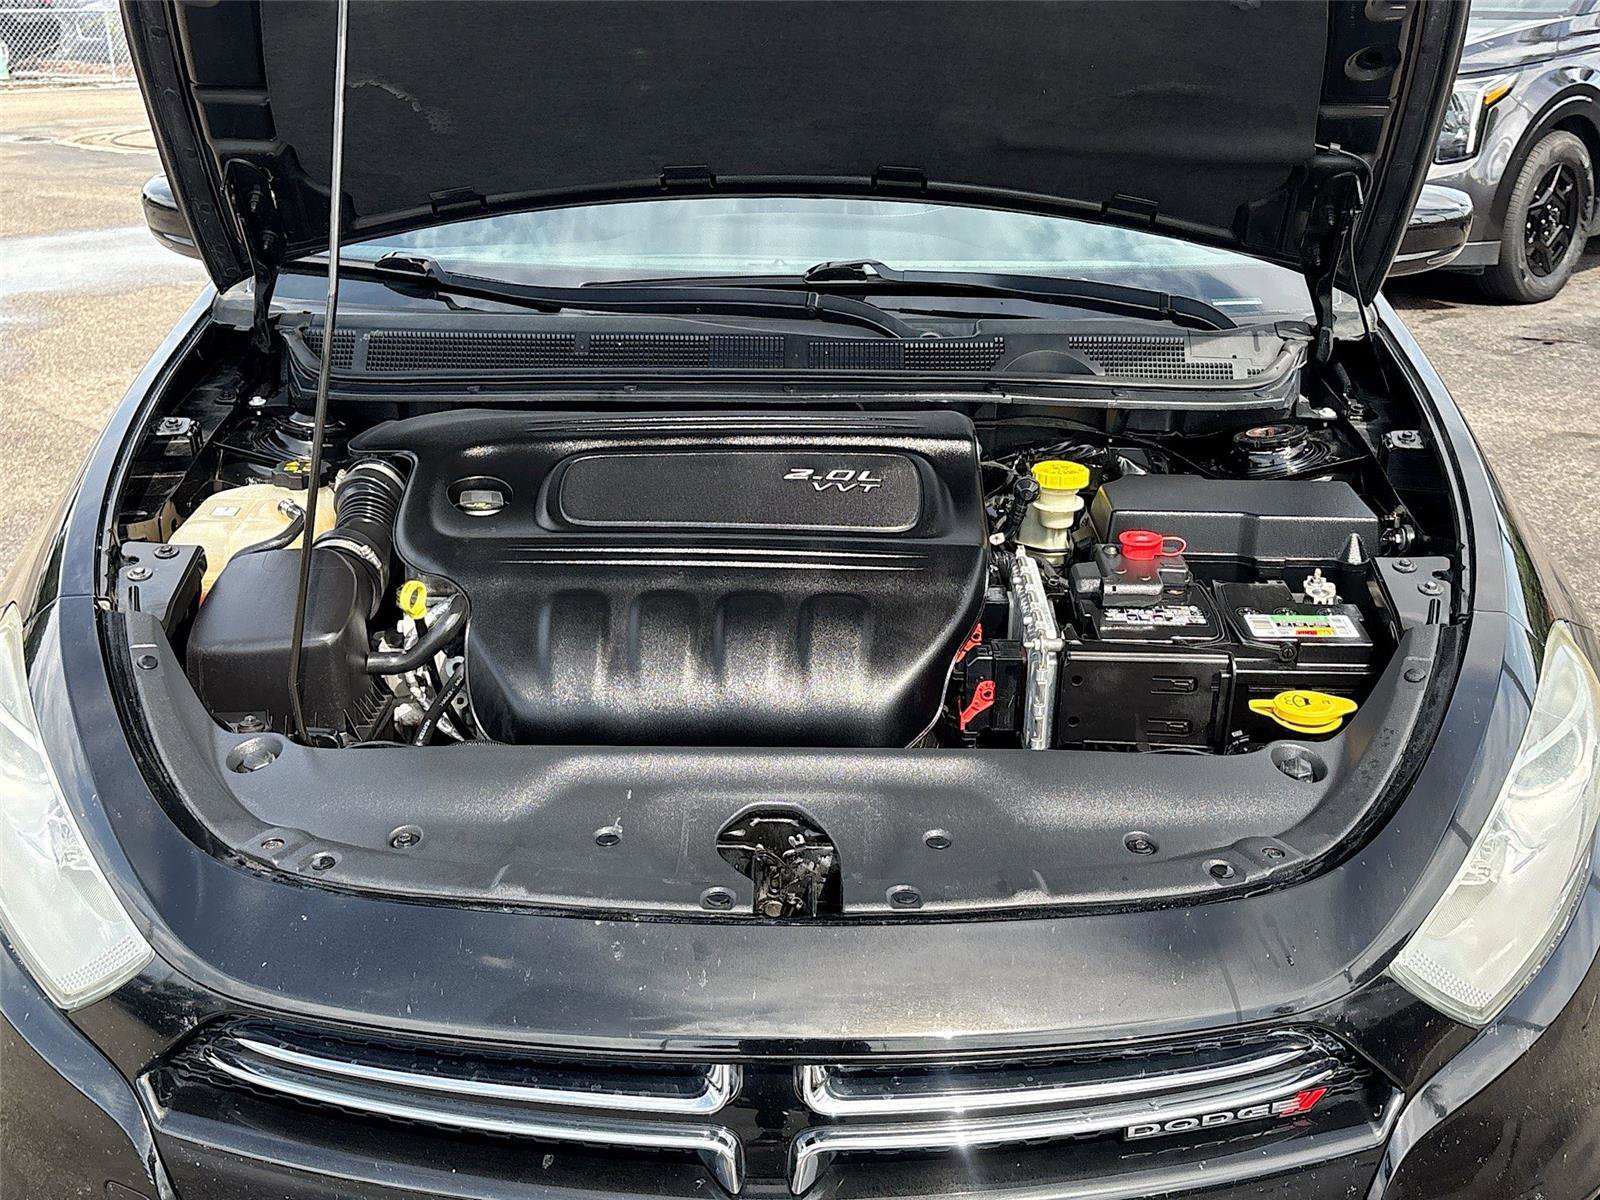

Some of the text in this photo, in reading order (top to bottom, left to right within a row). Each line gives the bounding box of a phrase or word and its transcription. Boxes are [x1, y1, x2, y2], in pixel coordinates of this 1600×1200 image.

[783, 468, 882, 481] 2.0L
[812, 481, 881, 492] VVT
[1127, 1098, 1300, 1138] DODGE
